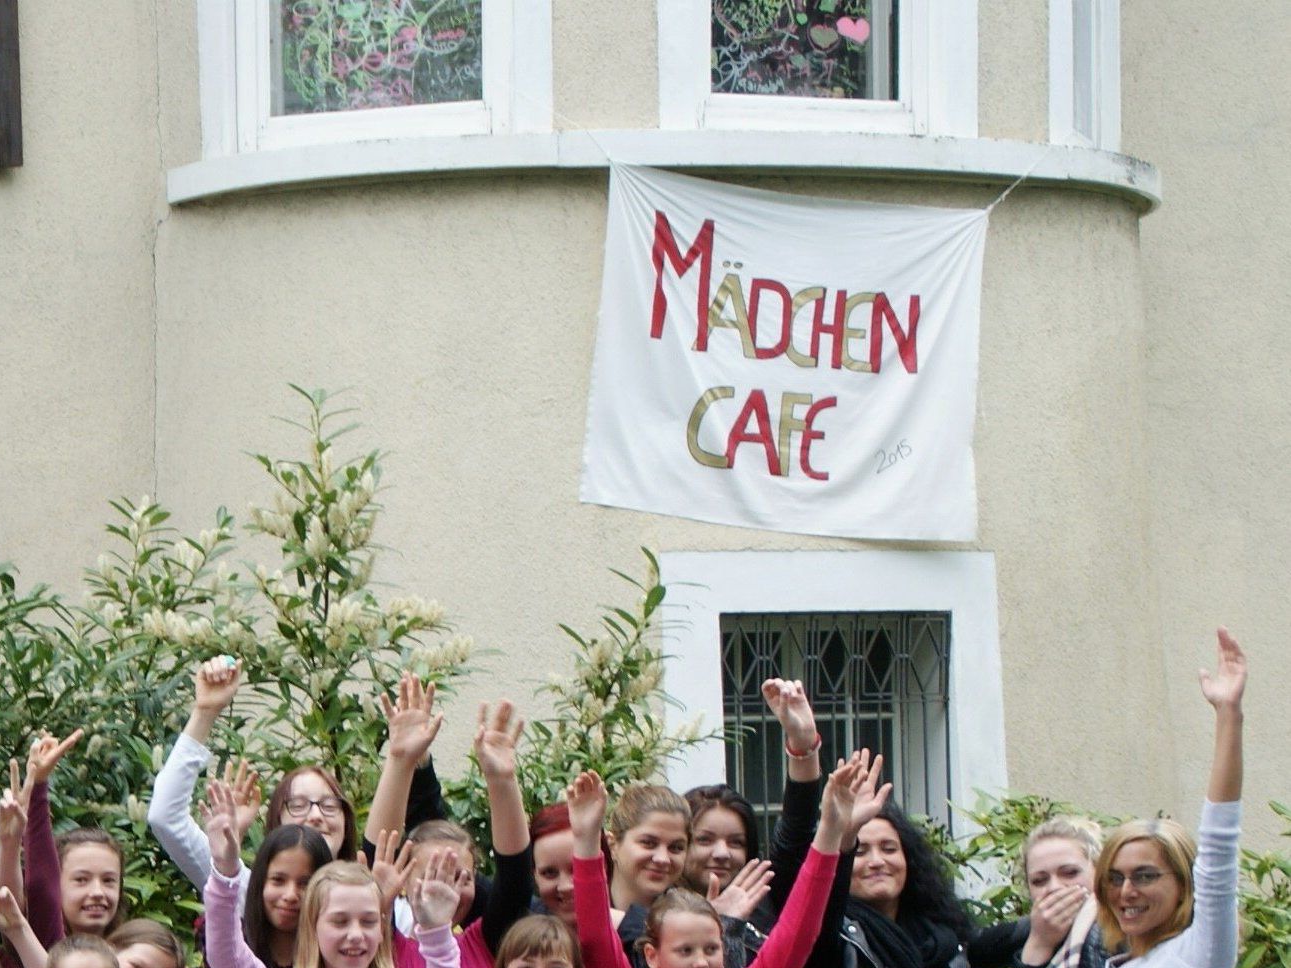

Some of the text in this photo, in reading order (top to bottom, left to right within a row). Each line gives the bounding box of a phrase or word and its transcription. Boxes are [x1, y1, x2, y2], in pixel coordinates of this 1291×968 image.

[650, 210, 920, 374] MÄDCHEN
[686, 386, 837, 481] CAFE
[873, 438, 912, 474] 2015
